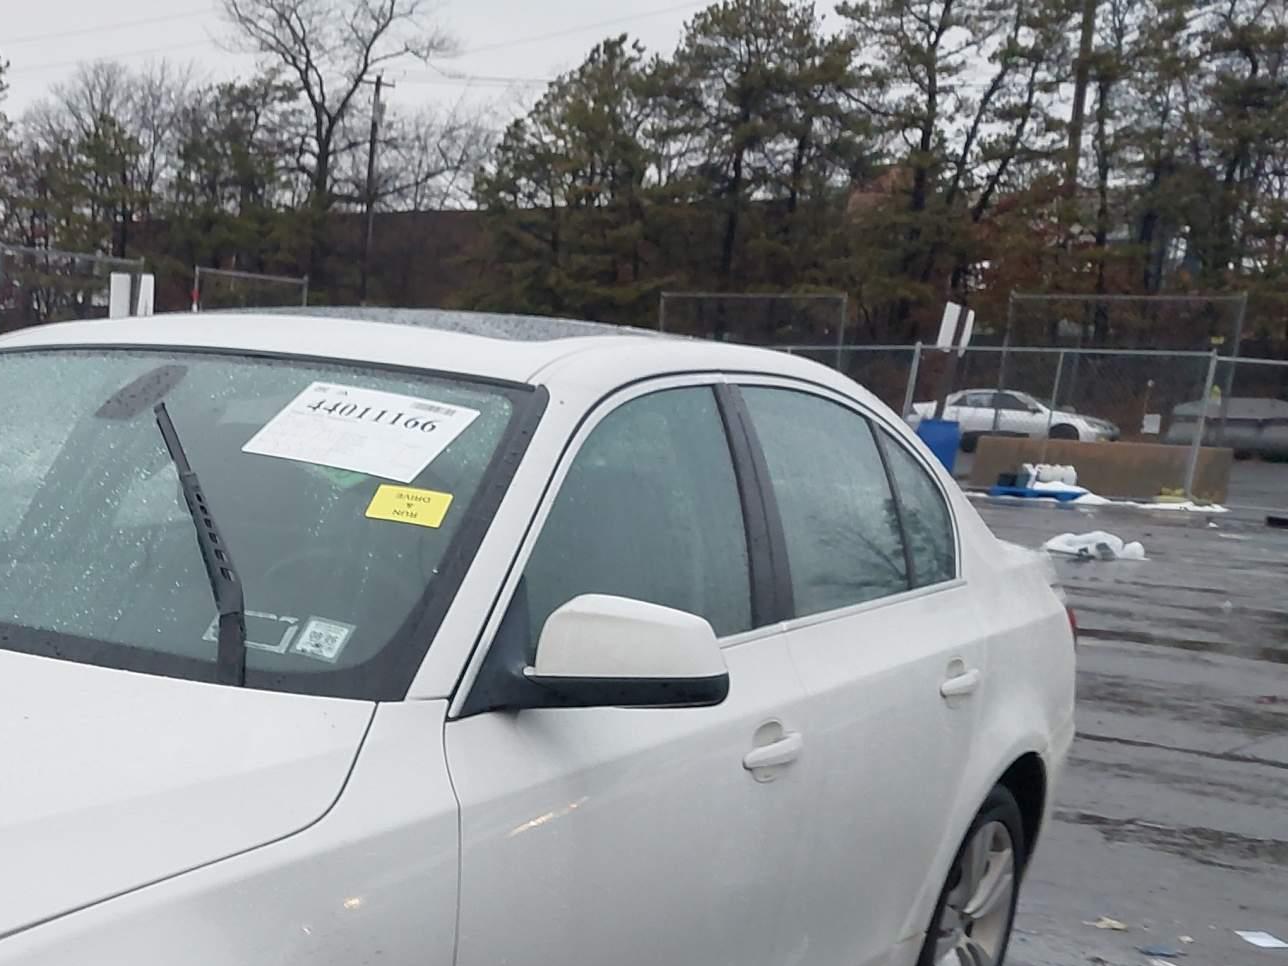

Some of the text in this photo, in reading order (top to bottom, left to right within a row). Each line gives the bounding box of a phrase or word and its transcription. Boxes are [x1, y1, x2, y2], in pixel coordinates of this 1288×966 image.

[307, 399, 437, 433] 44011166
[395, 492, 432, 504] DRIVE
[392, 508, 419, 519] RUN
